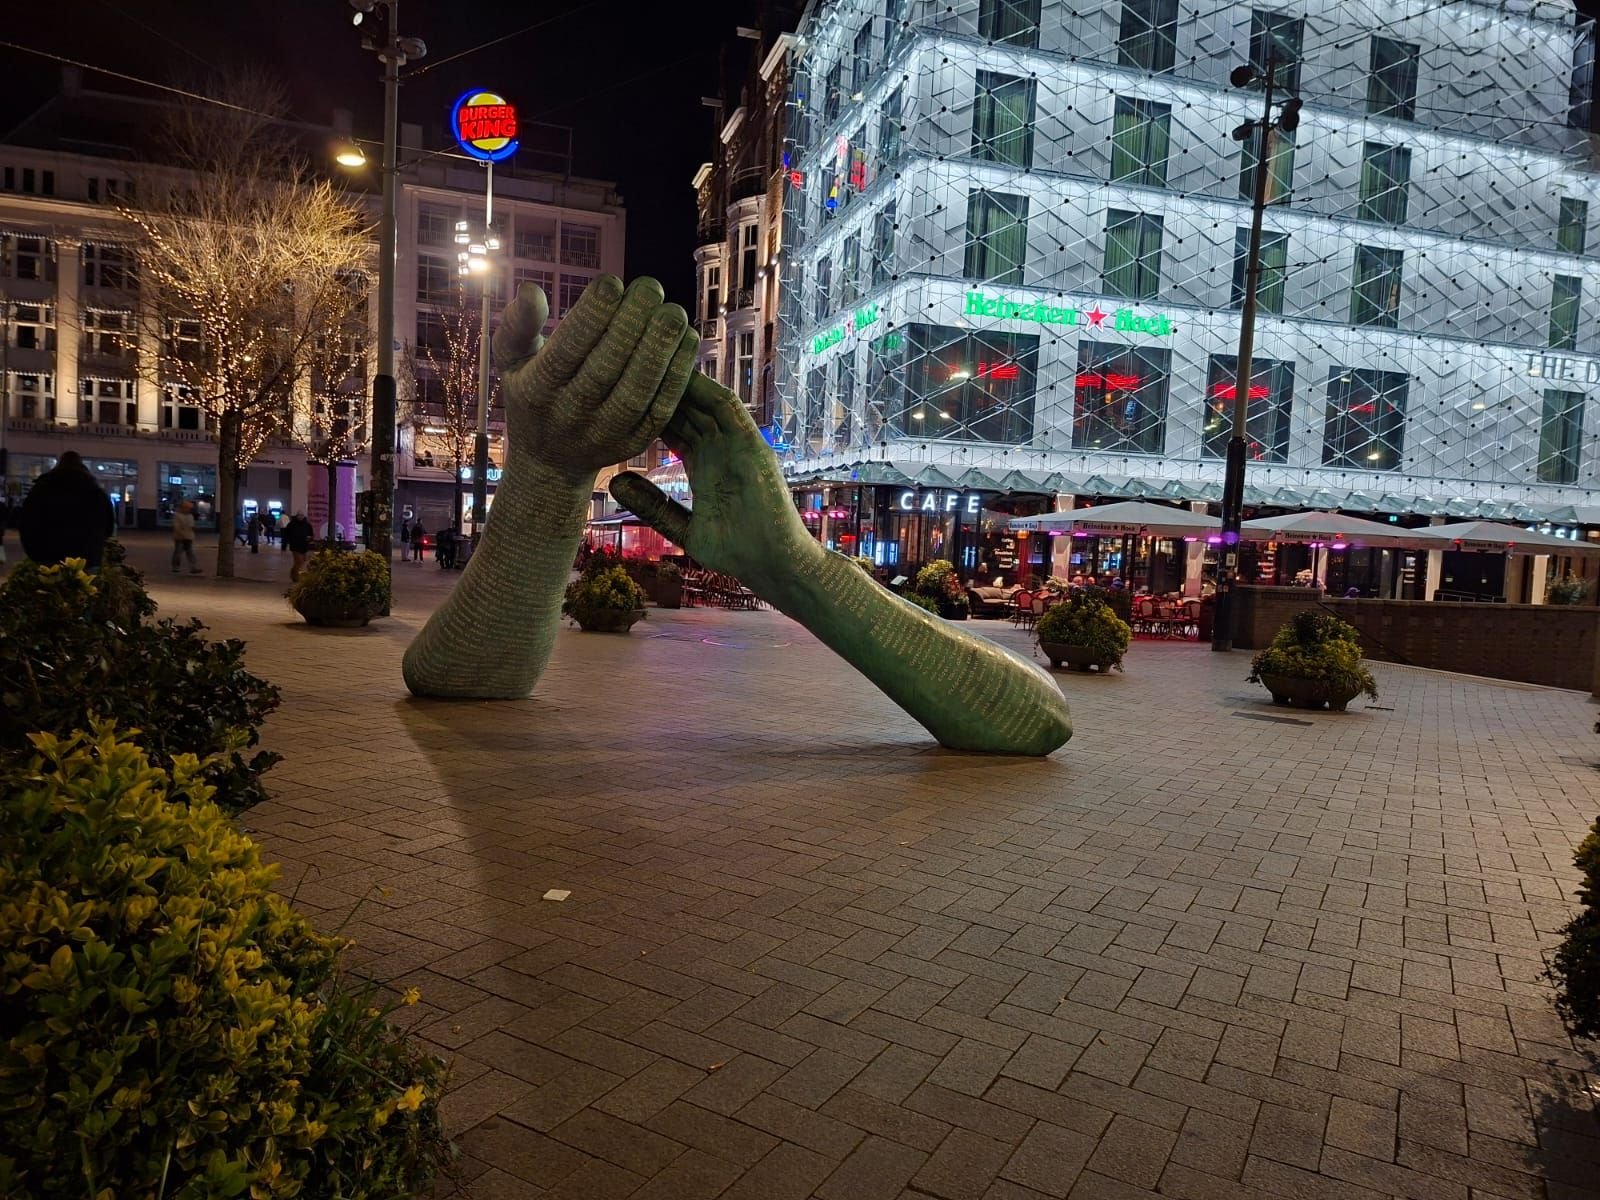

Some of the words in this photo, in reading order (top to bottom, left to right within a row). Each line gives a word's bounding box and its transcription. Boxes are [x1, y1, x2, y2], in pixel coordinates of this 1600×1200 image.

[460, 105, 514, 122] BURGER
[461, 120, 516, 140] KING
[965, 291, 1077, 326] Heineken
[1115, 308, 1172, 336] Hoek
[1526, 353, 1577, 381] THE
[402, 504, 413, 519] 5
[900, 492, 980, 513] CAFE
